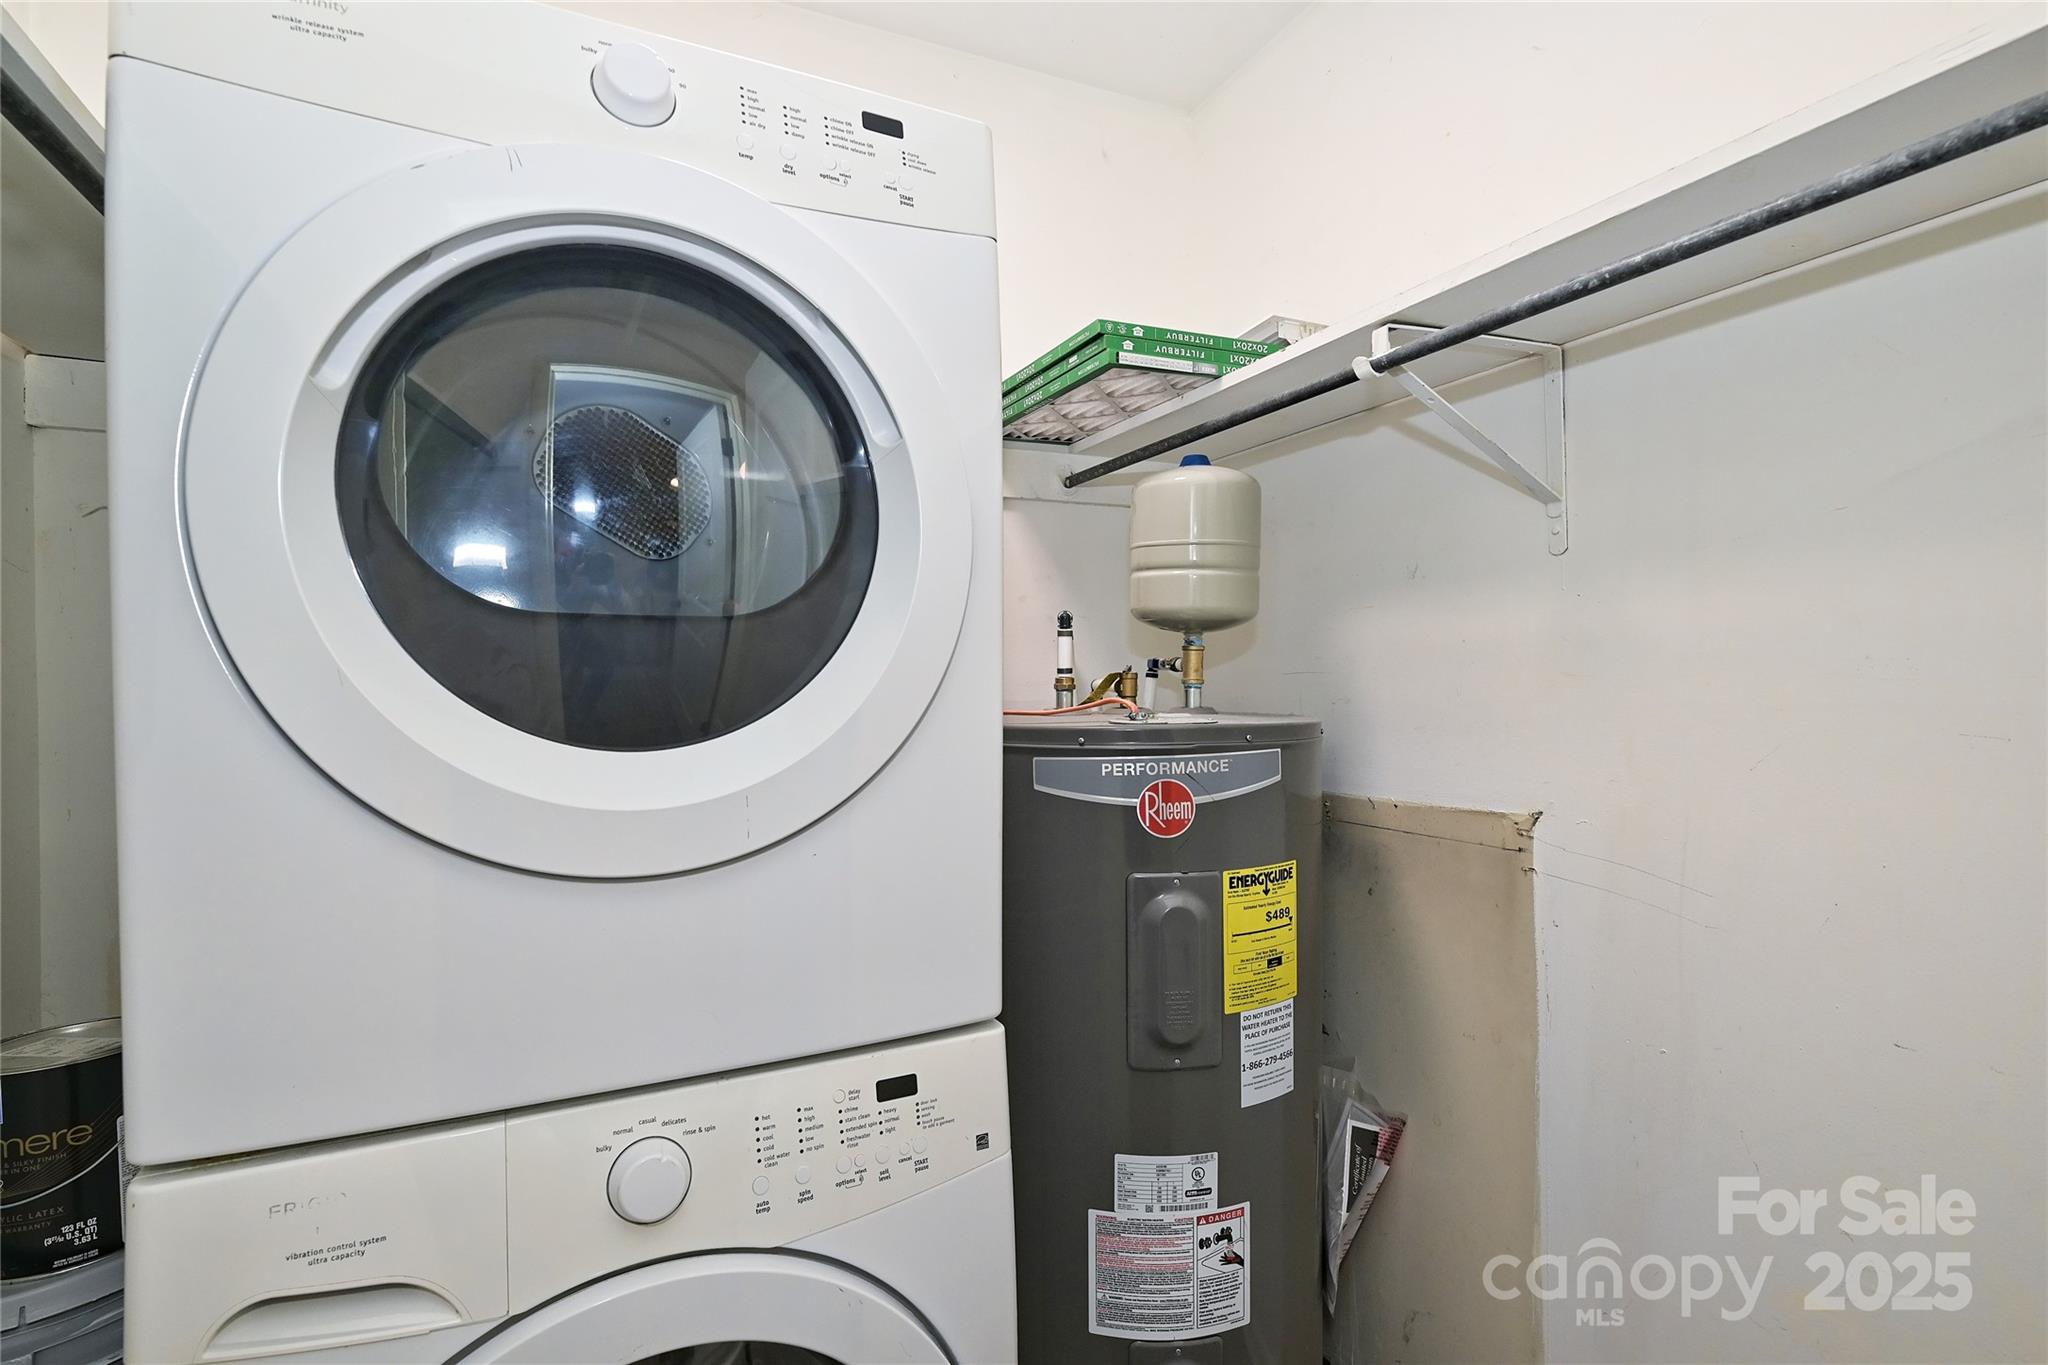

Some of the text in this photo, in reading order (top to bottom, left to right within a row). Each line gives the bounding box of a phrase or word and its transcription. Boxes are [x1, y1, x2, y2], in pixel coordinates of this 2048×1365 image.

[272, 14, 364, 38] wrinkle release system
[290, 25, 346, 42] ultra capacity
[580, 46, 598, 54] bulky
[789, 106, 801, 114] high
[790, 115, 807, 123] normal
[831, 125, 845, 133] chime
[831, 134, 848, 142] wrinkle
[849, 139, 865, 147] release
[832, 143, 849, 151] wrinkle
[850, 147, 866, 155] release
[738, 152, 754, 161] temp
[782, 168, 796, 176] level
[820, 173, 840, 182] options
[899, 194, 914, 202] START
[900, 200, 914, 208] pause
[1166, 332, 1214, 345] FILTERBUY
[1232, 340, 1268, 353] 20x20x1
[1155, 345, 1205, 359] FILTERBUY
[1101, 760, 1229, 777] PERFORMANCE
[1145, 782, 1192, 828] Rheem
[1229, 866, 1294, 889] ENERGYGUIDE
[1266, 907, 1290, 922] $489
[1243, 1003, 1291, 1022] DO NOT RETURN THIS
[1242, 1022, 1260, 1031] WATER
[1261, 1018, 1278, 1027] HEATER
[1244, 1030, 1260, 1040] PLACE
[1268, 1021, 1290, 1034] PURCHASE
[1242, 1048, 1293, 1073] 1-866-279-4566
[638, 1116, 657, 1125] casual
[661, 1117, 687, 1127] delicates
[804, 1115, 816, 1123] high
[613, 1126, 634, 1136] normal
[698, 1126, 703, 1134] &
[704, 1124, 716, 1133] spin
[805, 1124, 824, 1132] medium
[846, 1124, 867, 1133] extended
[846, 1133, 871, 1142] freshwater
[596, 1145, 612, 1153] bulky
[763, 1144, 774, 1152] cold
[1355, 1142, 1362, 1154] of
[12, 1159, 34, 1167] SILKY
[37, 1152, 67, 1162] FINISH
[764, 1151, 791, 1162] cold water
[898, 1156, 912, 1164] cancel
[914, 1157, 928, 1166] START
[22, 1164, 40, 1173] ONE
[915, 1165, 929, 1174] pause
[835, 1178, 856, 1188] options
[879, 1174, 891, 1182] level
[799, 1189, 811, 1197] spin
[756, 1200, 770, 1208] auto
[798, 1194, 814, 1204] speed
[28, 1206, 64, 1219] LATEX
[756, 1206, 771, 1214] temp
[1208, 1210, 1242, 1223] DANGER
[5, 1222, 51, 1233] WARRANTY
[61, 1217, 97, 1234] 123 FL OZ
[66, 1230, 82, 1240] U.S.
[74, 1235, 91, 1246] 3.63
[286, 1235, 387, 1261] vibration control system
[308, 1250, 366, 1267] ultra capacity
